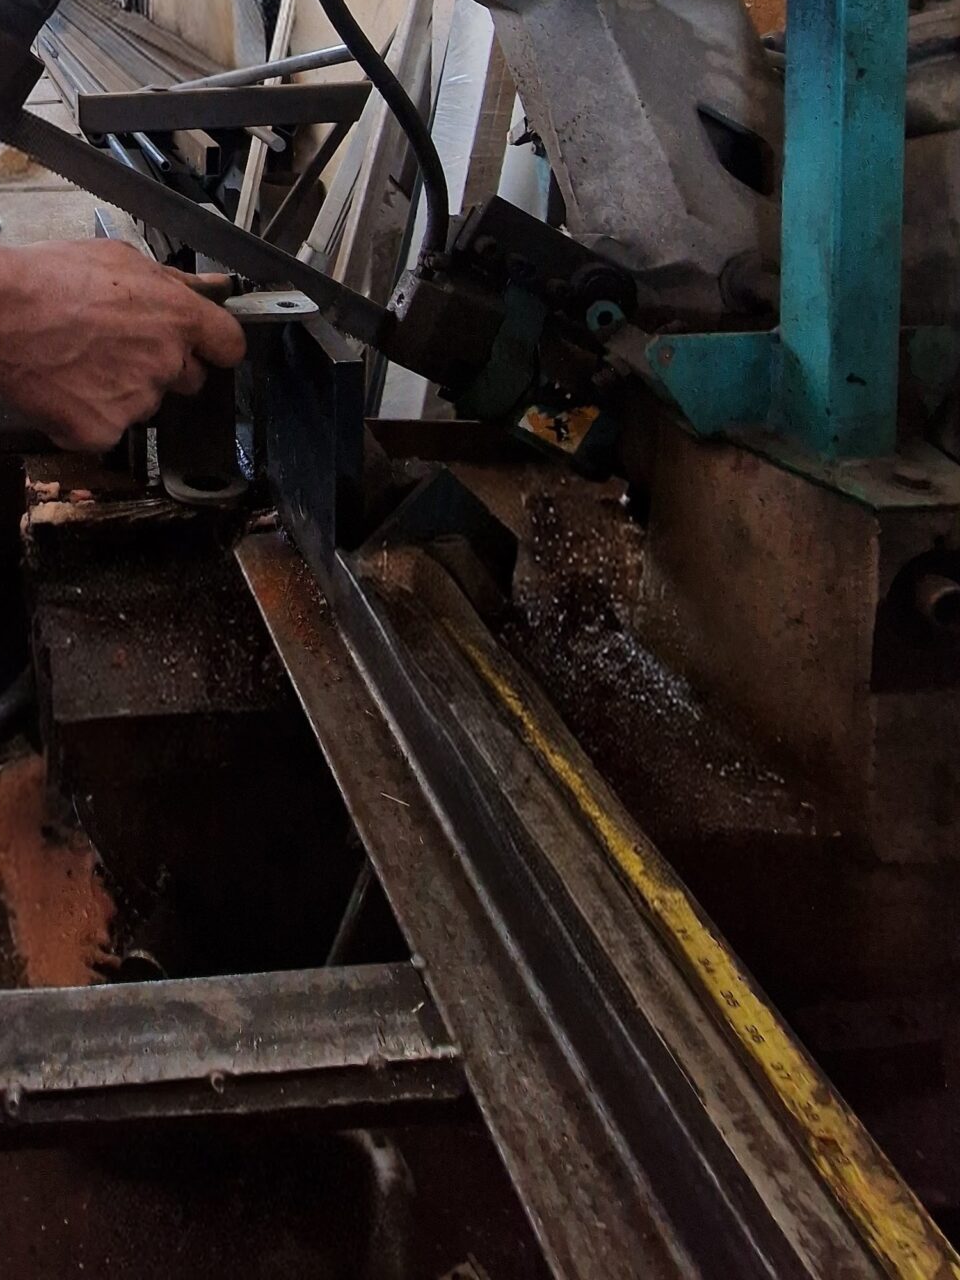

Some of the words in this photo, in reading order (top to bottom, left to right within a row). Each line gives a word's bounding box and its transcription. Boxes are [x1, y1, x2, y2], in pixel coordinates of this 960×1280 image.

[720, 990, 741, 1008] 35
[744, 1024, 765, 1045] 36
[770, 1062, 793, 1081] 37
